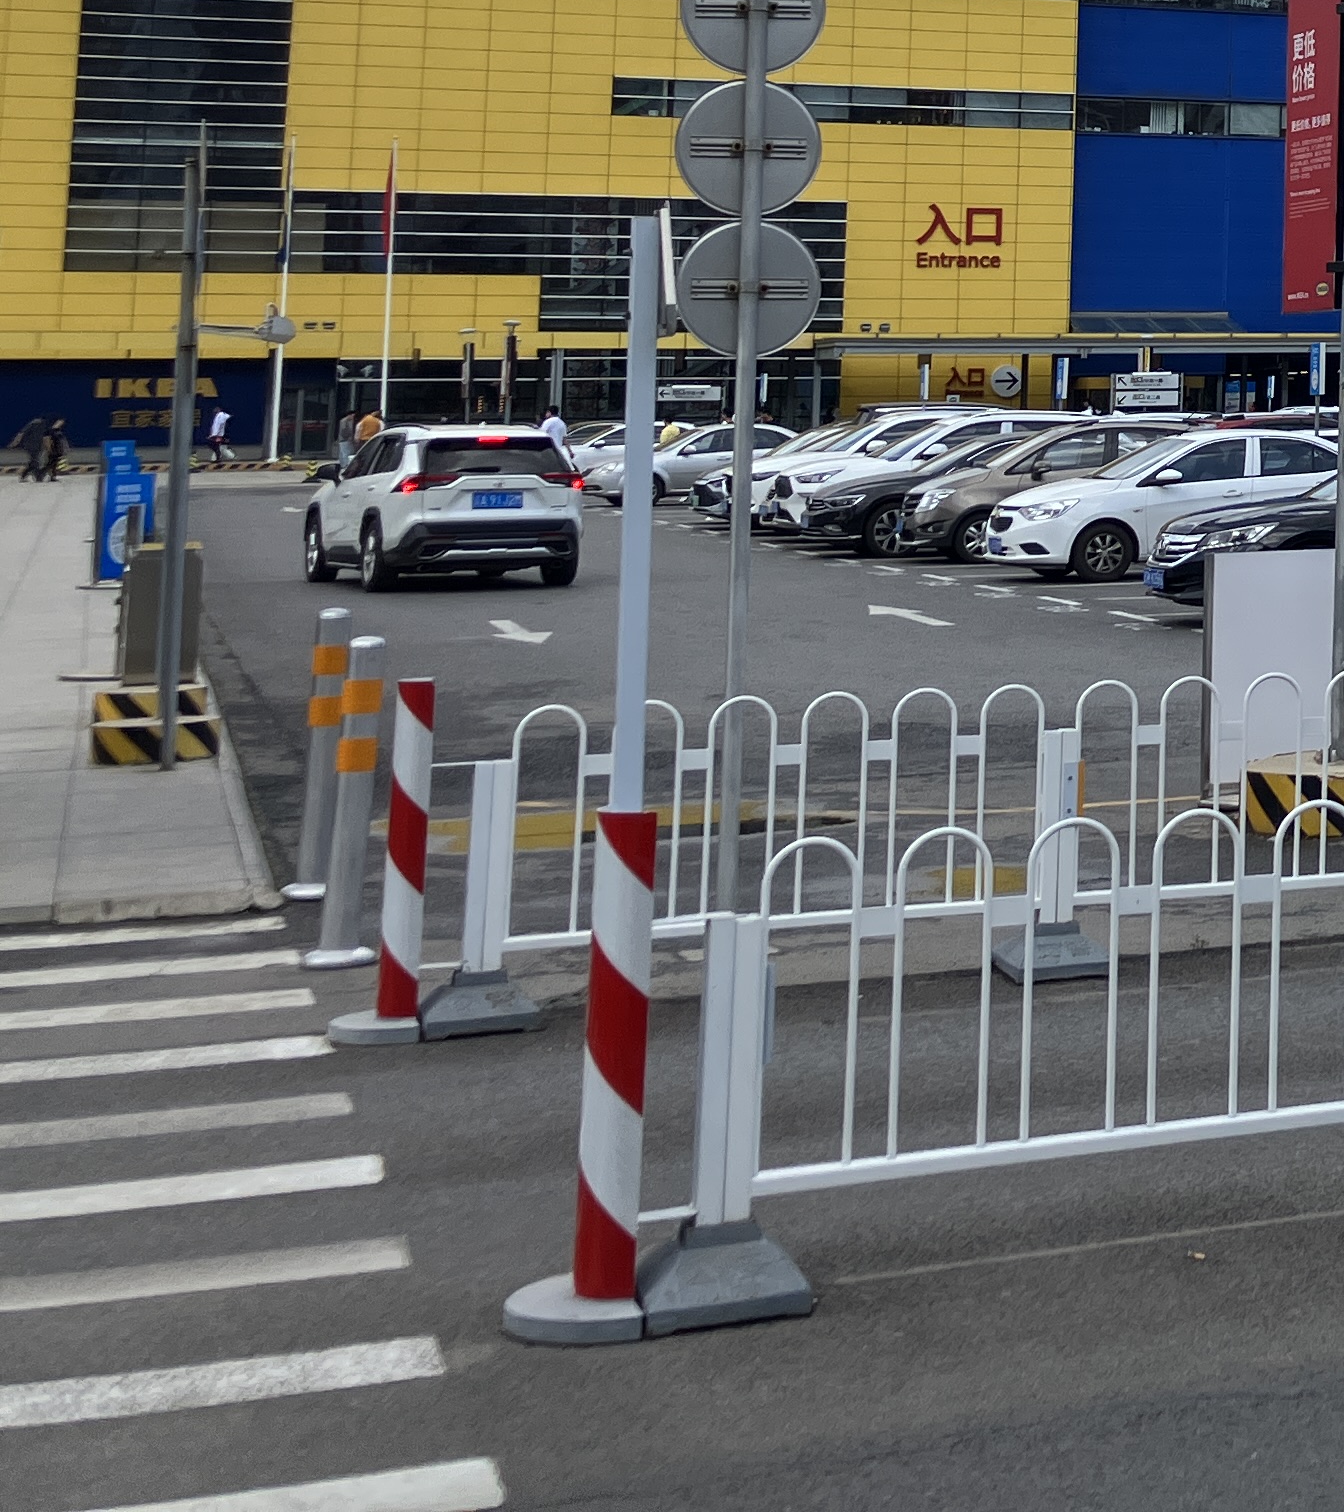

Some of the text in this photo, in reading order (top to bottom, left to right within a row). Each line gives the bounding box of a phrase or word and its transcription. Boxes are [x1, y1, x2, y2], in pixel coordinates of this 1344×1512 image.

[1292, 29, 1315, 61] 更低
[1292, 62, 1315, 93] 价格
[916, 203, 1003, 246] 入口
[916, 252, 1001, 268] Entrance
[945, 367, 984, 387] 入口
